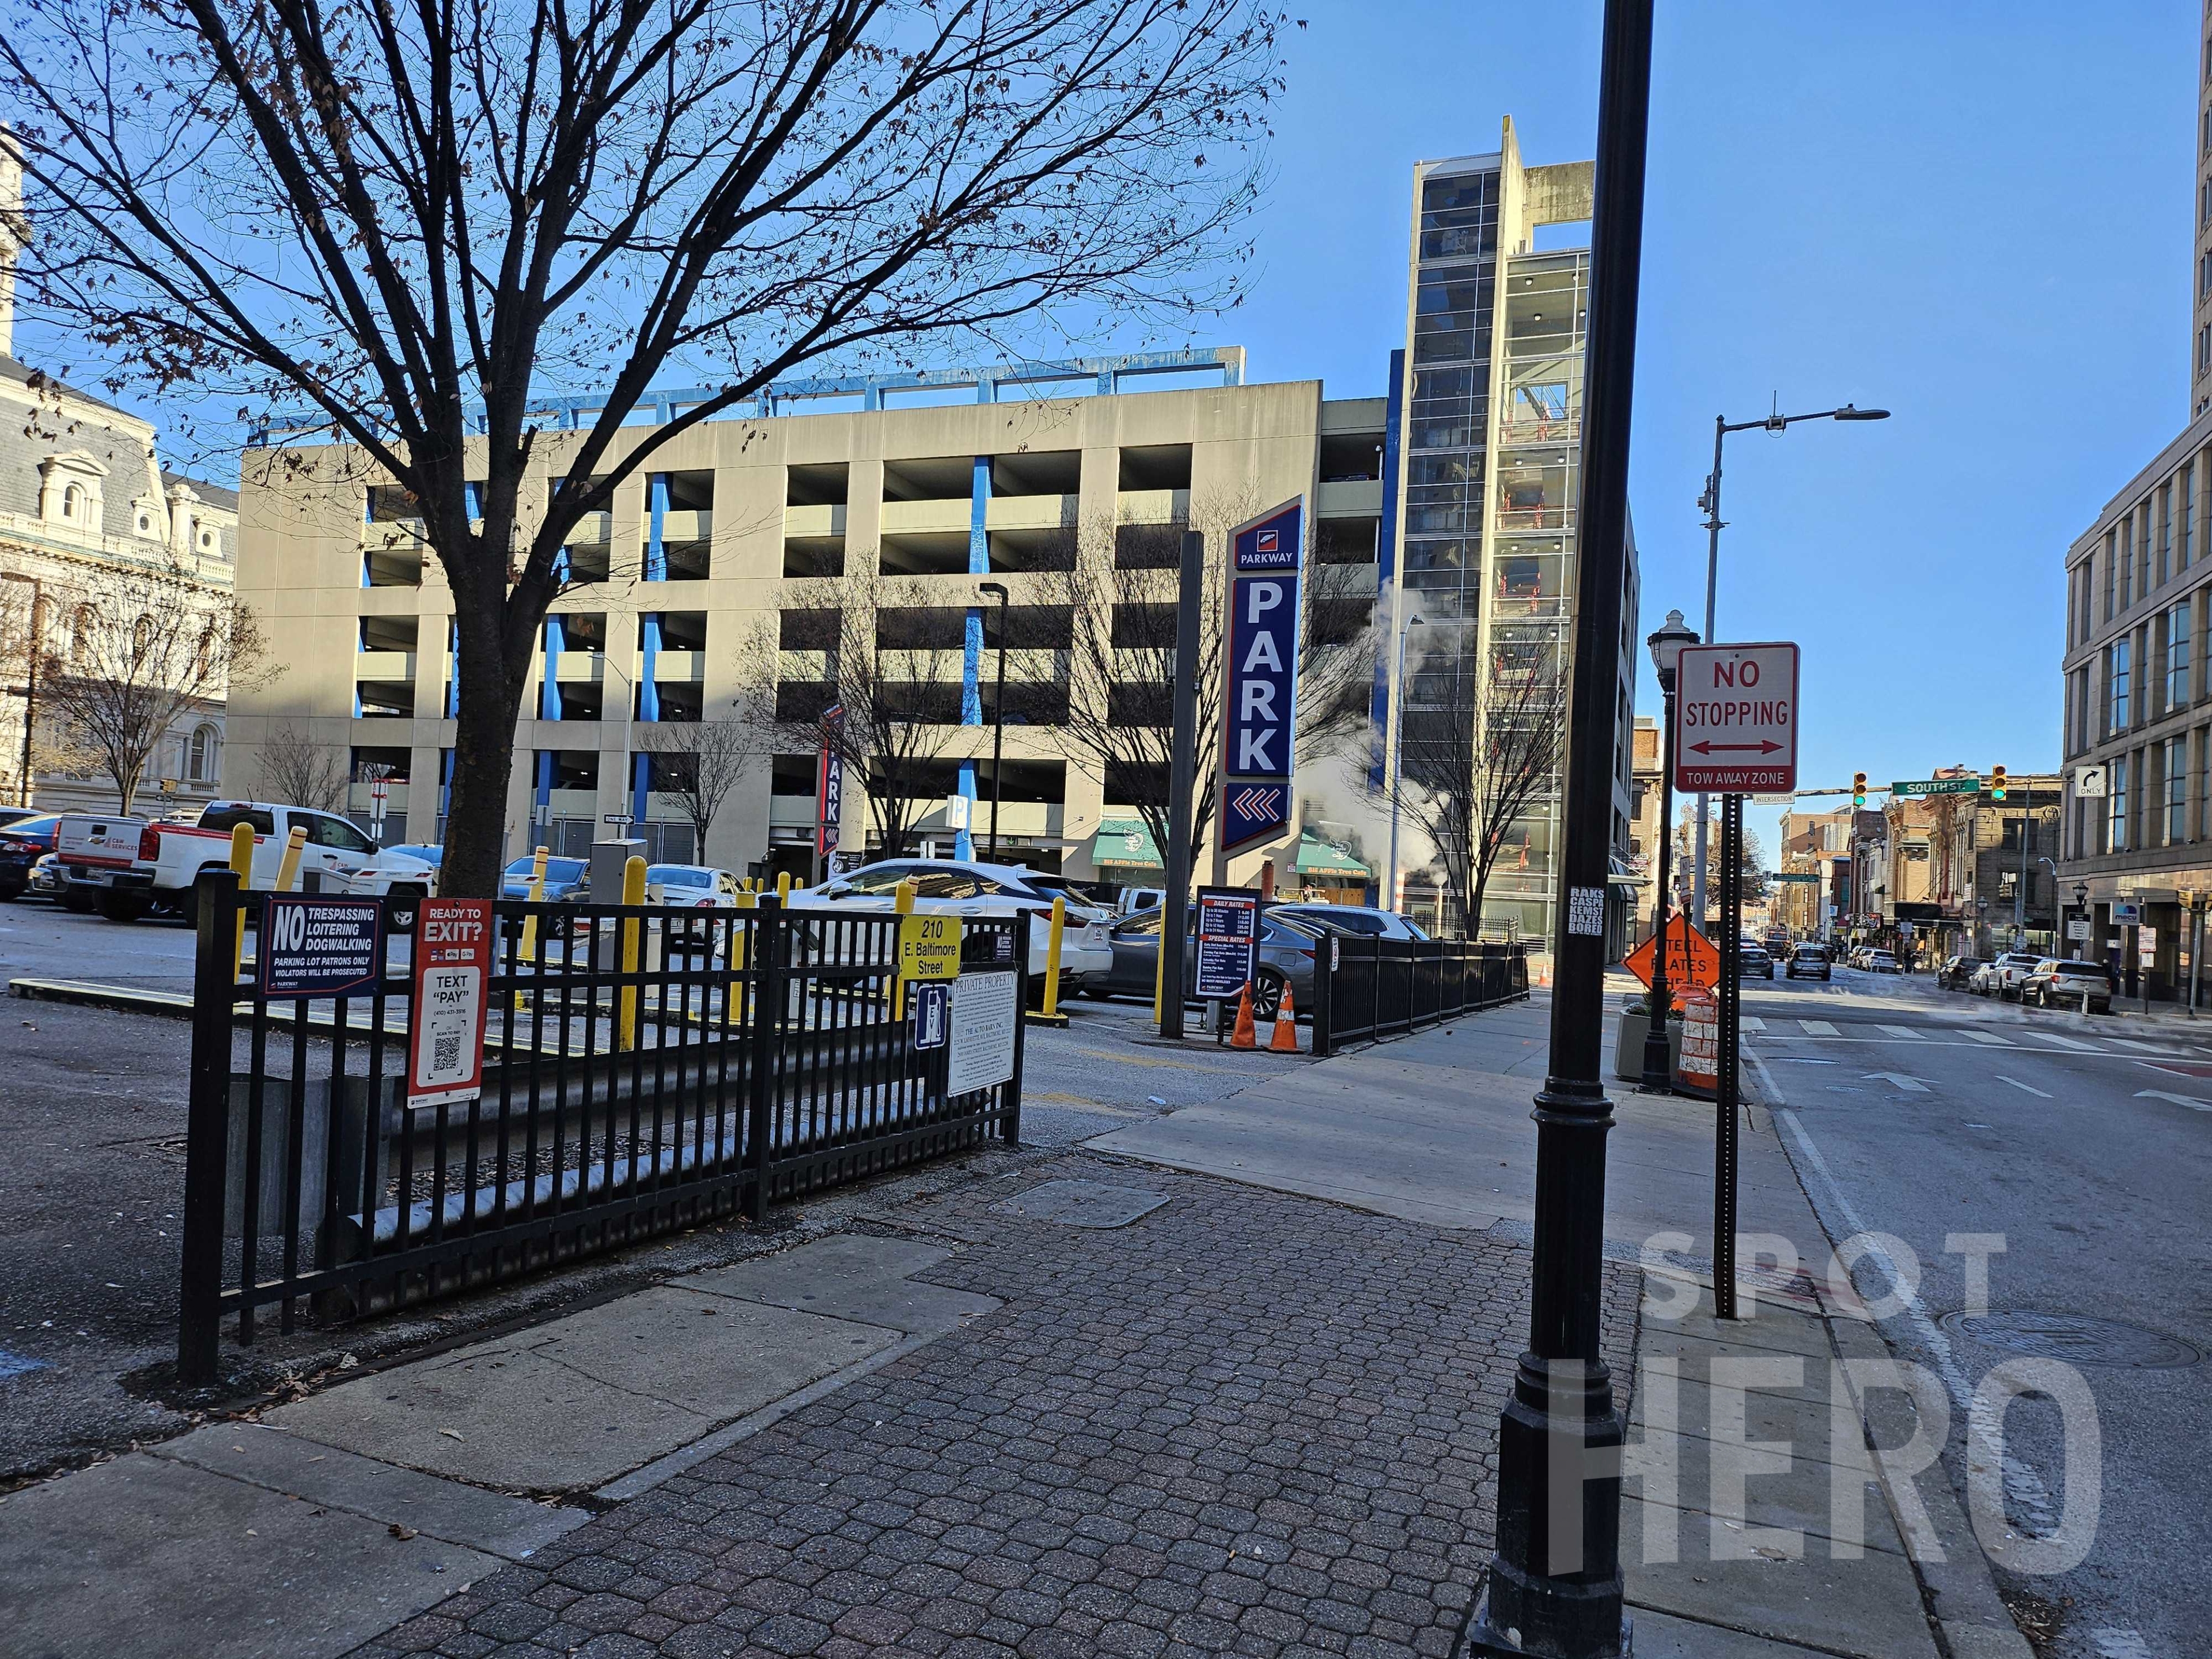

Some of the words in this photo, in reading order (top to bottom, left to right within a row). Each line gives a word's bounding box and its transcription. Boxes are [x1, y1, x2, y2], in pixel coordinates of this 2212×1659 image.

[1241, 552, 1293, 564] PARKWAY
[1239, 582, 1283, 771] PARK
[1714, 661, 1760, 688] NO
[1686, 701, 1787, 726] STOPPING
[1687, 772, 1713, 785] TOW
[1715, 772, 1749, 785] AWAY
[1751, 772, 1785, 784] ZONE
[827, 752, 840, 822] ARK
[1907, 782, 1948, 793] SOUTH
[1950, 783, 1965, 791] ST.
[955, 798, 964, 820] P
[1570, 888, 1604, 899] RAKS
[1570, 897, 1603, 907] CASPA
[308, 908, 374, 921] TRESPASSING
[430, 909, 465, 918] READY
[467, 909, 481, 919] TO
[1570, 905, 1603, 916] KEMST
[1569, 914, 1603, 925] DAZES
[272, 905, 305, 951] NO
[306, 923, 359, 935] LOITERING
[424, 922, 482, 942] EXIT?
[921, 920, 943, 938] 210
[1569, 923, 1602, 933] BORED
[306, 938, 372, 951] DOGWALKING
[905, 942, 913, 957] E.
[916, 942, 956, 956] Baltimore
[274, 957, 305, 966] PARKING
[307, 957, 320, 966] LOT
[321, 957, 351, 965] PATRONS
[353, 957, 370, 965] ONLY
[918, 960, 943, 974] Street
[437, 975, 468, 988] TEXT
[956, 977, 982, 993] PRIVATE
[984, 973, 1014, 989] PROPERTY
[929, 1007, 935, 1030] EV
